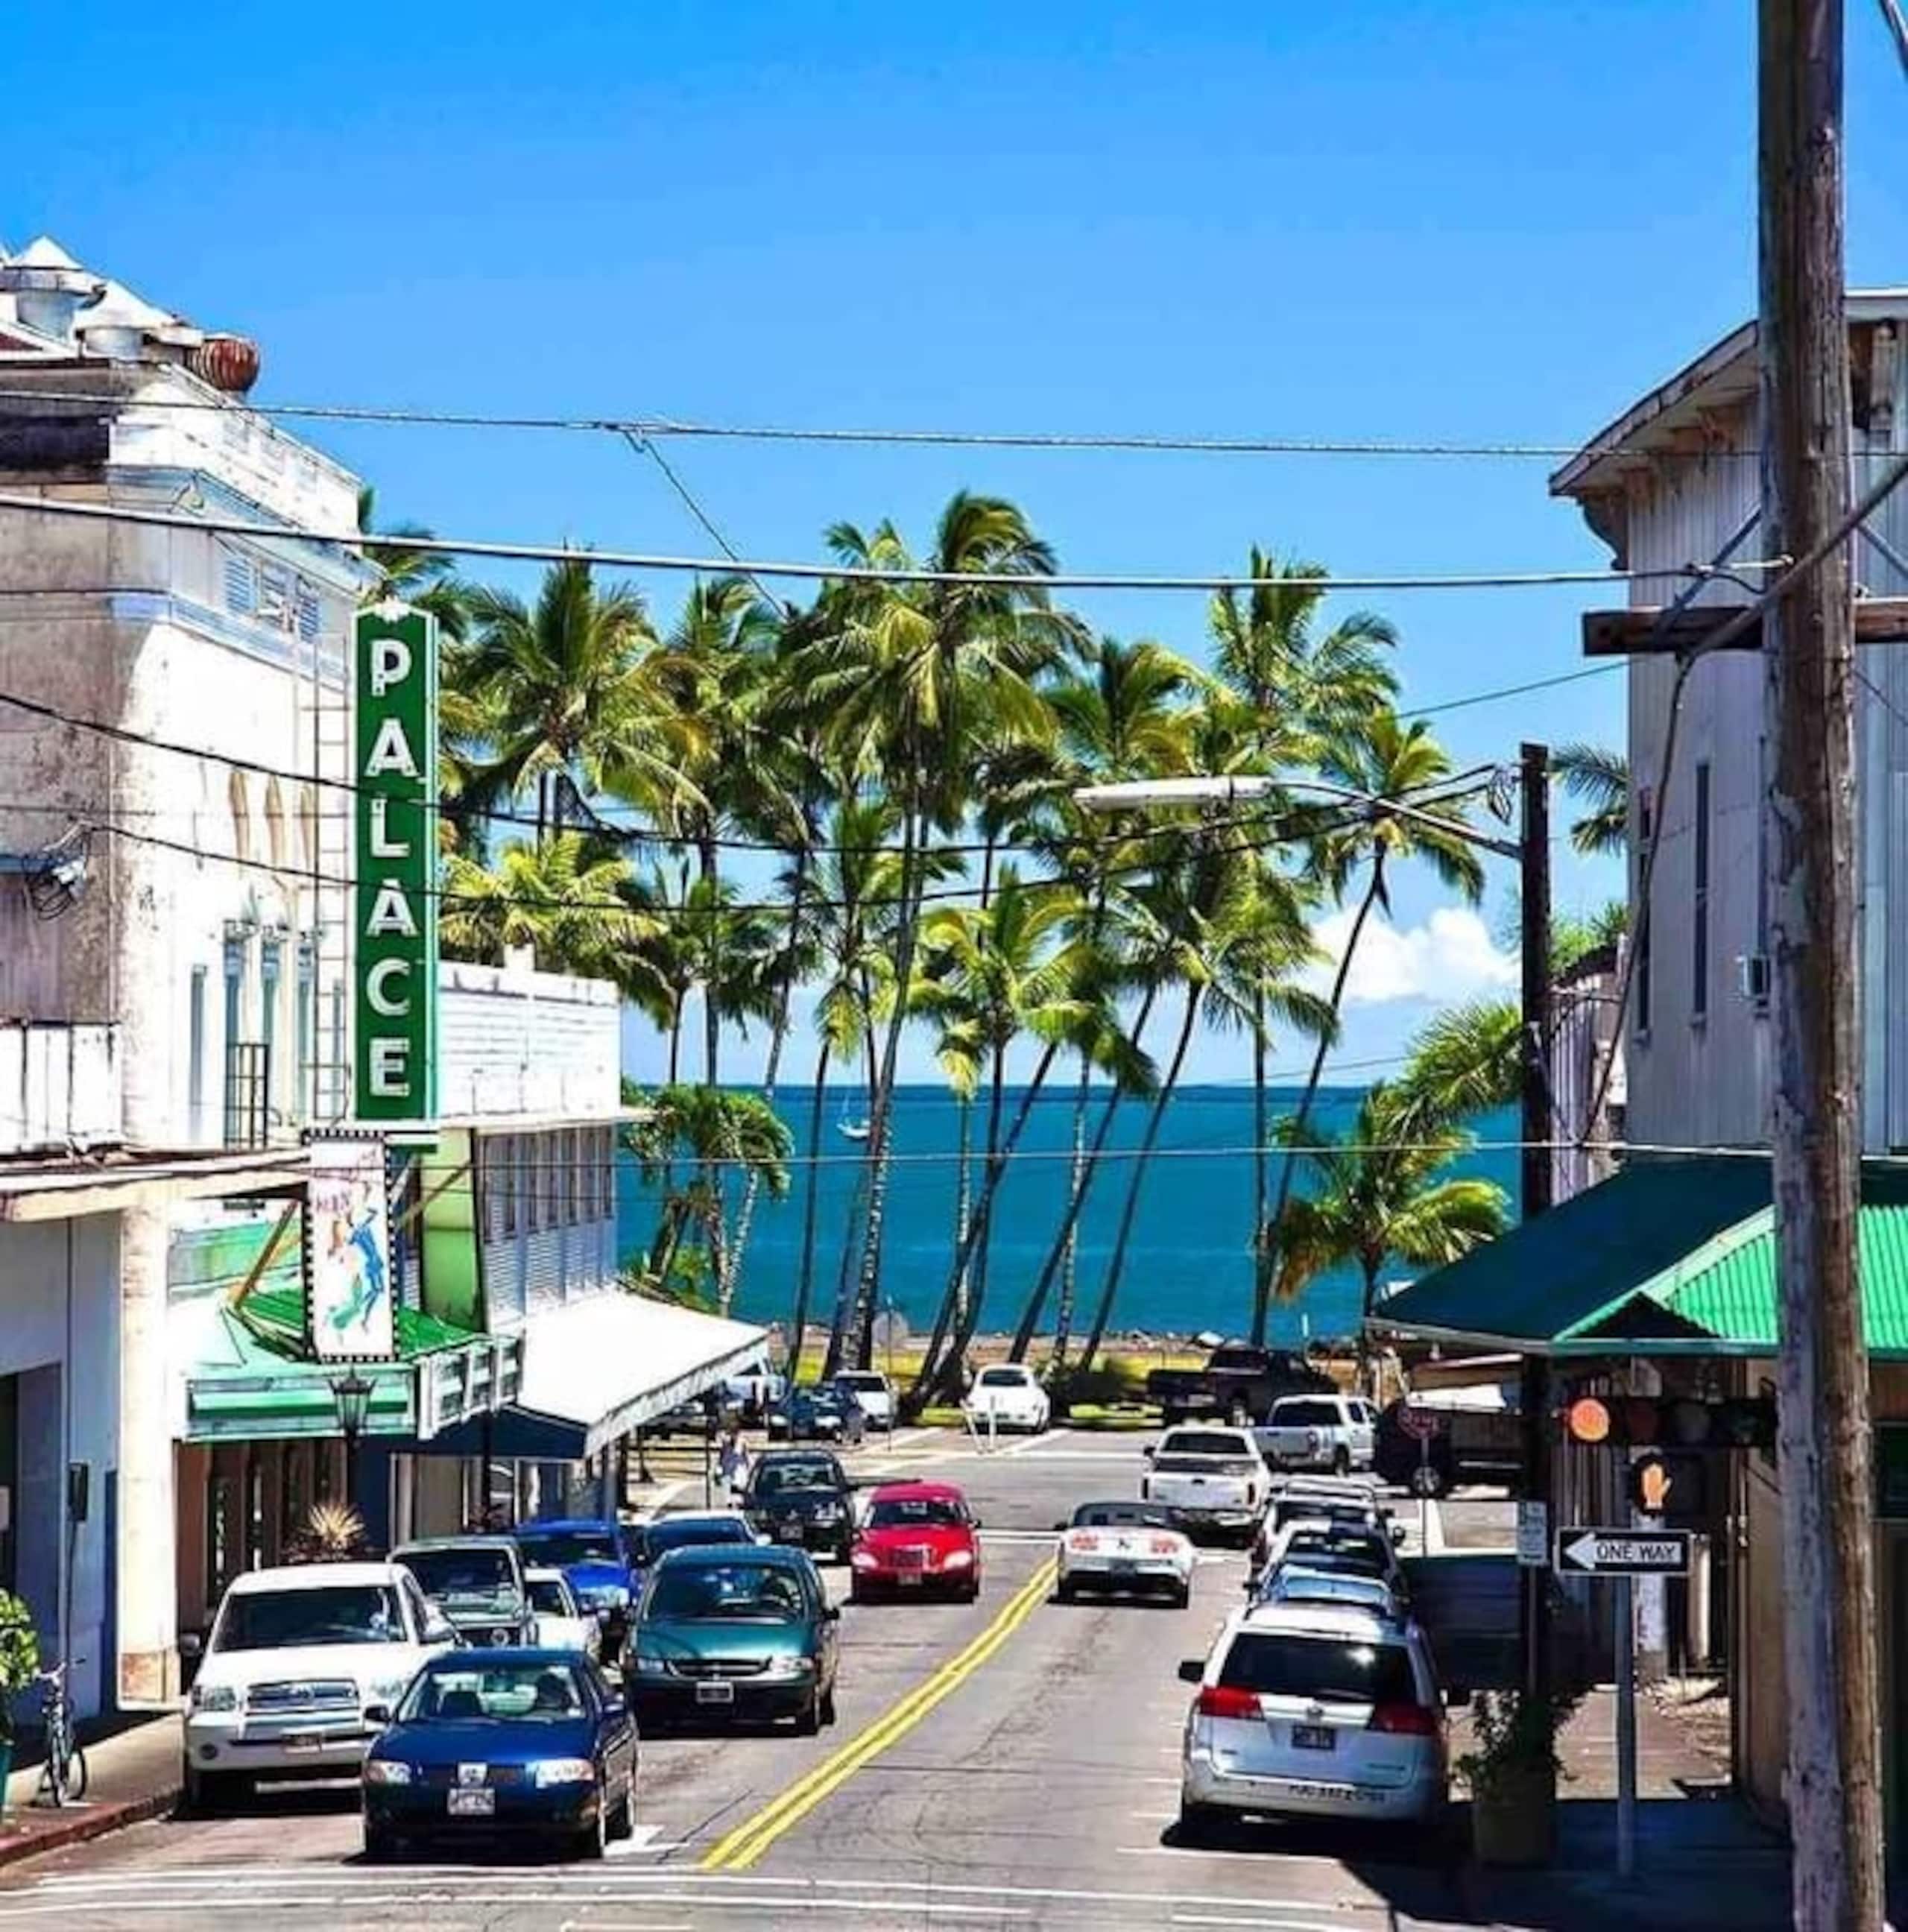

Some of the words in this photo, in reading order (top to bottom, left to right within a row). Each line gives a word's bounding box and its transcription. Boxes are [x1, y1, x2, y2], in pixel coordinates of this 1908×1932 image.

[365, 639, 419, 1096] PALACE
[1596, 1542, 1632, 1560] ONE
[1639, 1544, 1675, 1560] WAY
